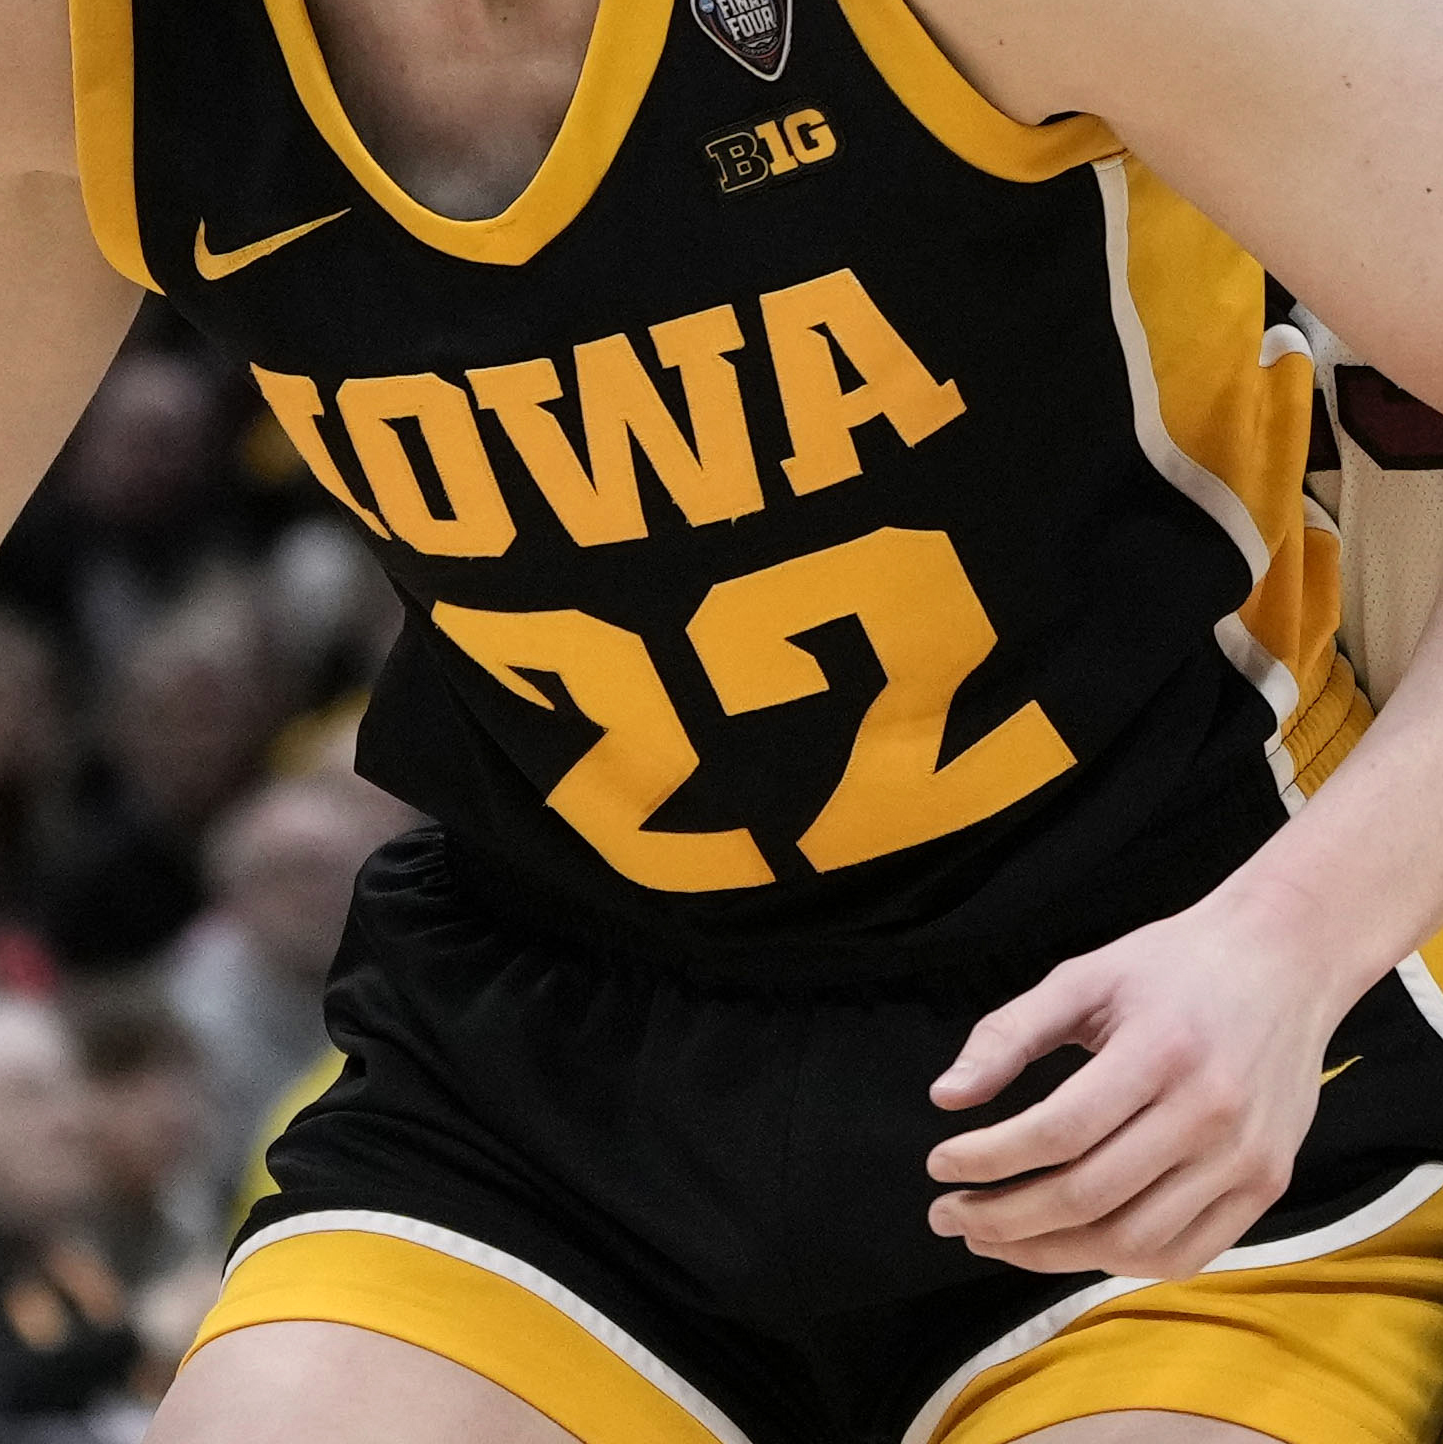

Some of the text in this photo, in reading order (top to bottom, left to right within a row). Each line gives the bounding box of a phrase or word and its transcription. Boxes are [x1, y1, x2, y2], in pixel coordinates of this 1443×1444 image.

[724, 7, 777, 42] FOUR
[250, 267, 966, 557] IOWA
[431, 526, 1078, 893] 22
